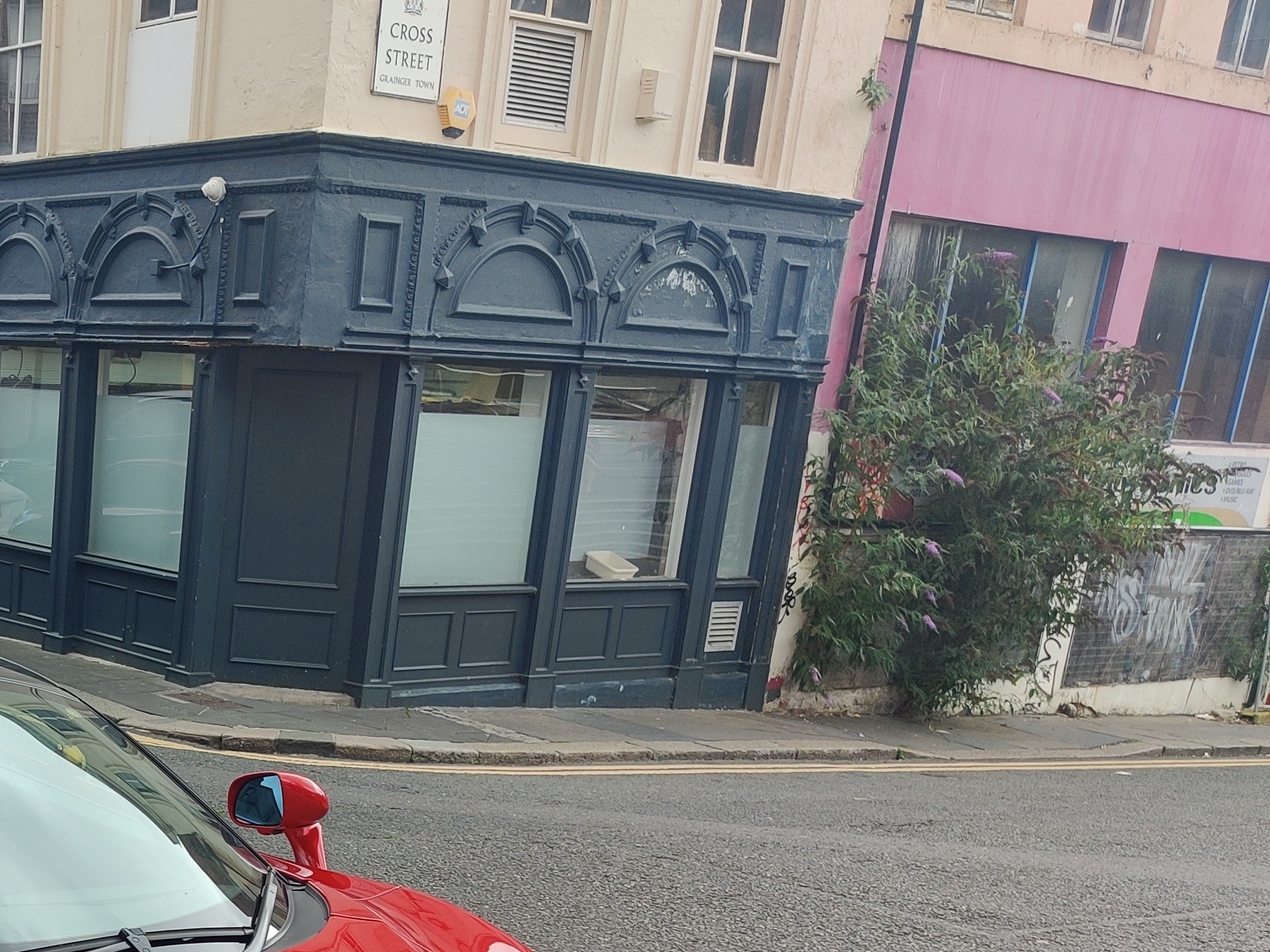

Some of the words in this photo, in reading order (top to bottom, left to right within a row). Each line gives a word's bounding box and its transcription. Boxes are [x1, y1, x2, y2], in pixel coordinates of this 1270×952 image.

[390, 22, 433, 44] CROSS
[385, 48, 433, 71] STREET
[379, 74, 411, 87] GRAINGER
[415, 79, 435, 90] TOWN
[454, 102, 471, 117] ADT
